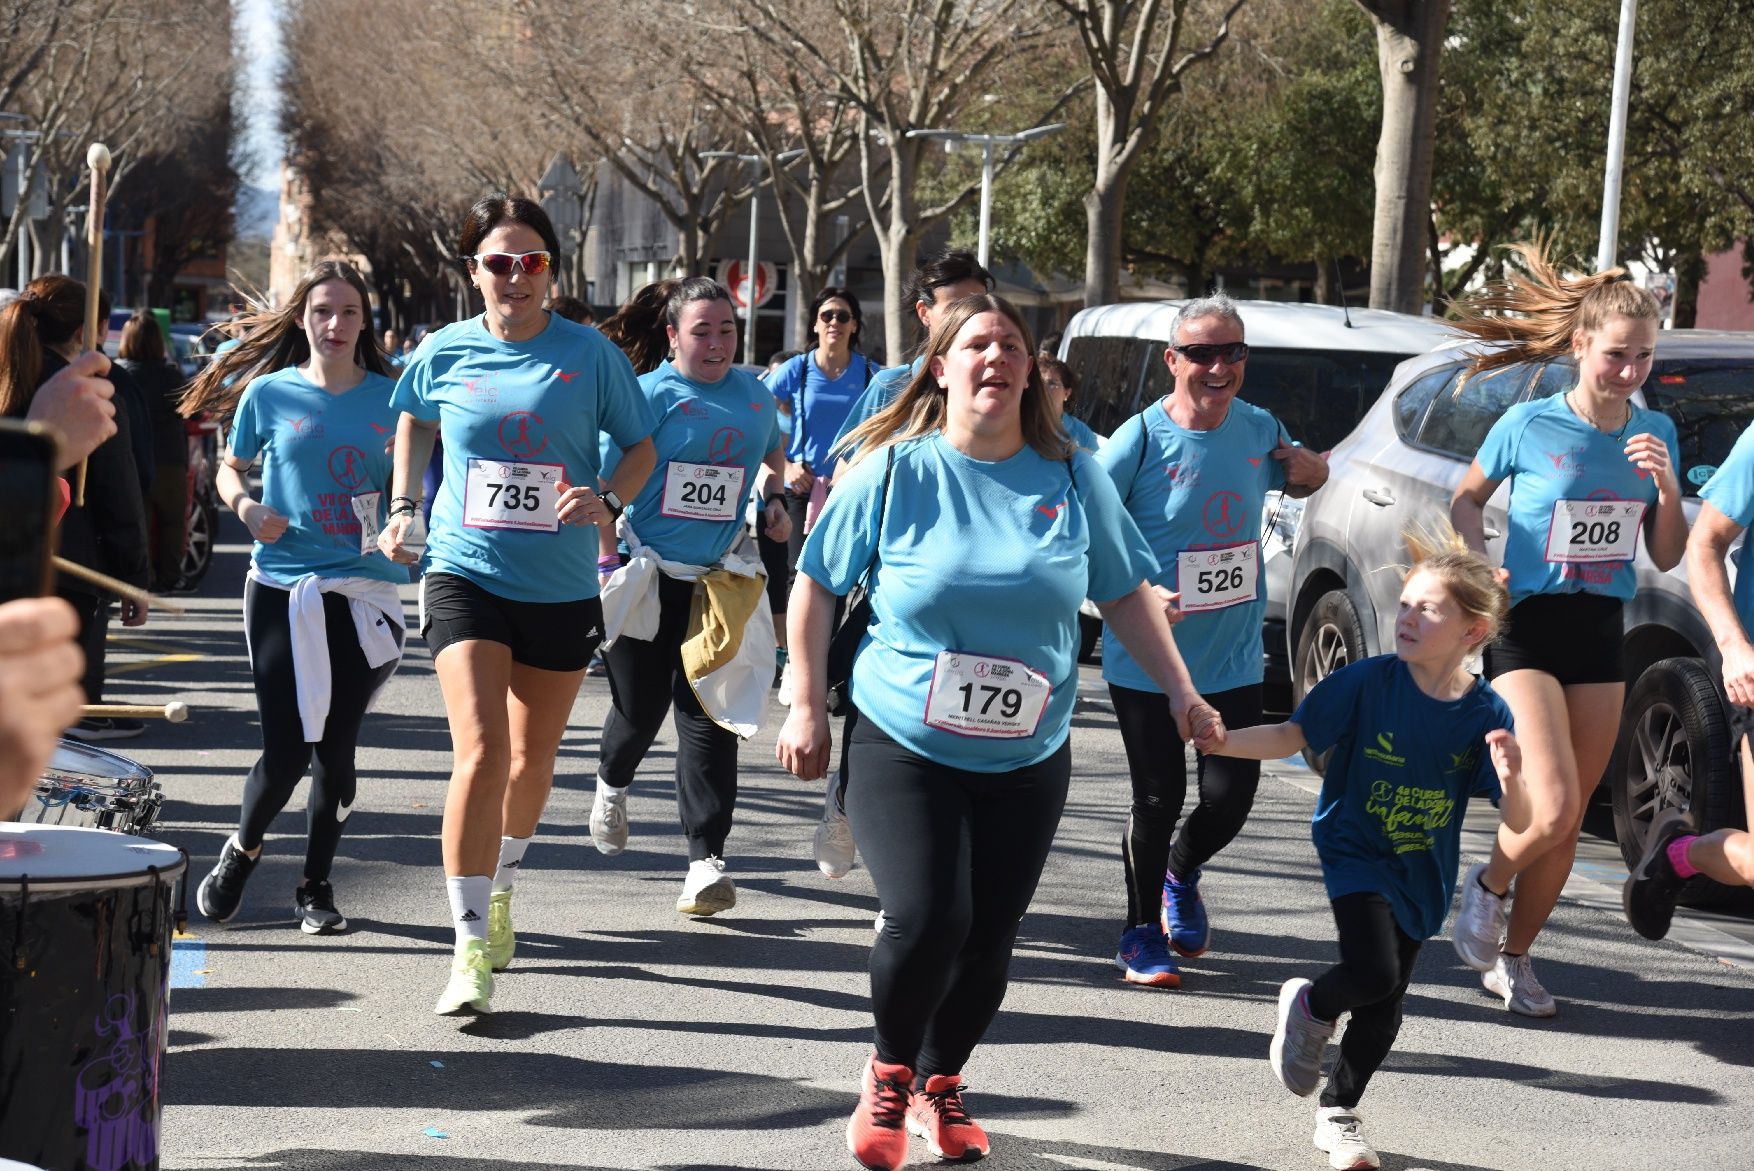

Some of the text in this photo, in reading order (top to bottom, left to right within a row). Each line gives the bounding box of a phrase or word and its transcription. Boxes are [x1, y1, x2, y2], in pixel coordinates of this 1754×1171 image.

[486, 483, 540, 512] 735
[681, 481, 726, 506] 204
[1569, 520, 1621, 545] 208
[1197, 566, 1243, 594] 526
[959, 682, 1022, 719] 179
[1411, 787, 1446, 800] CURSA
